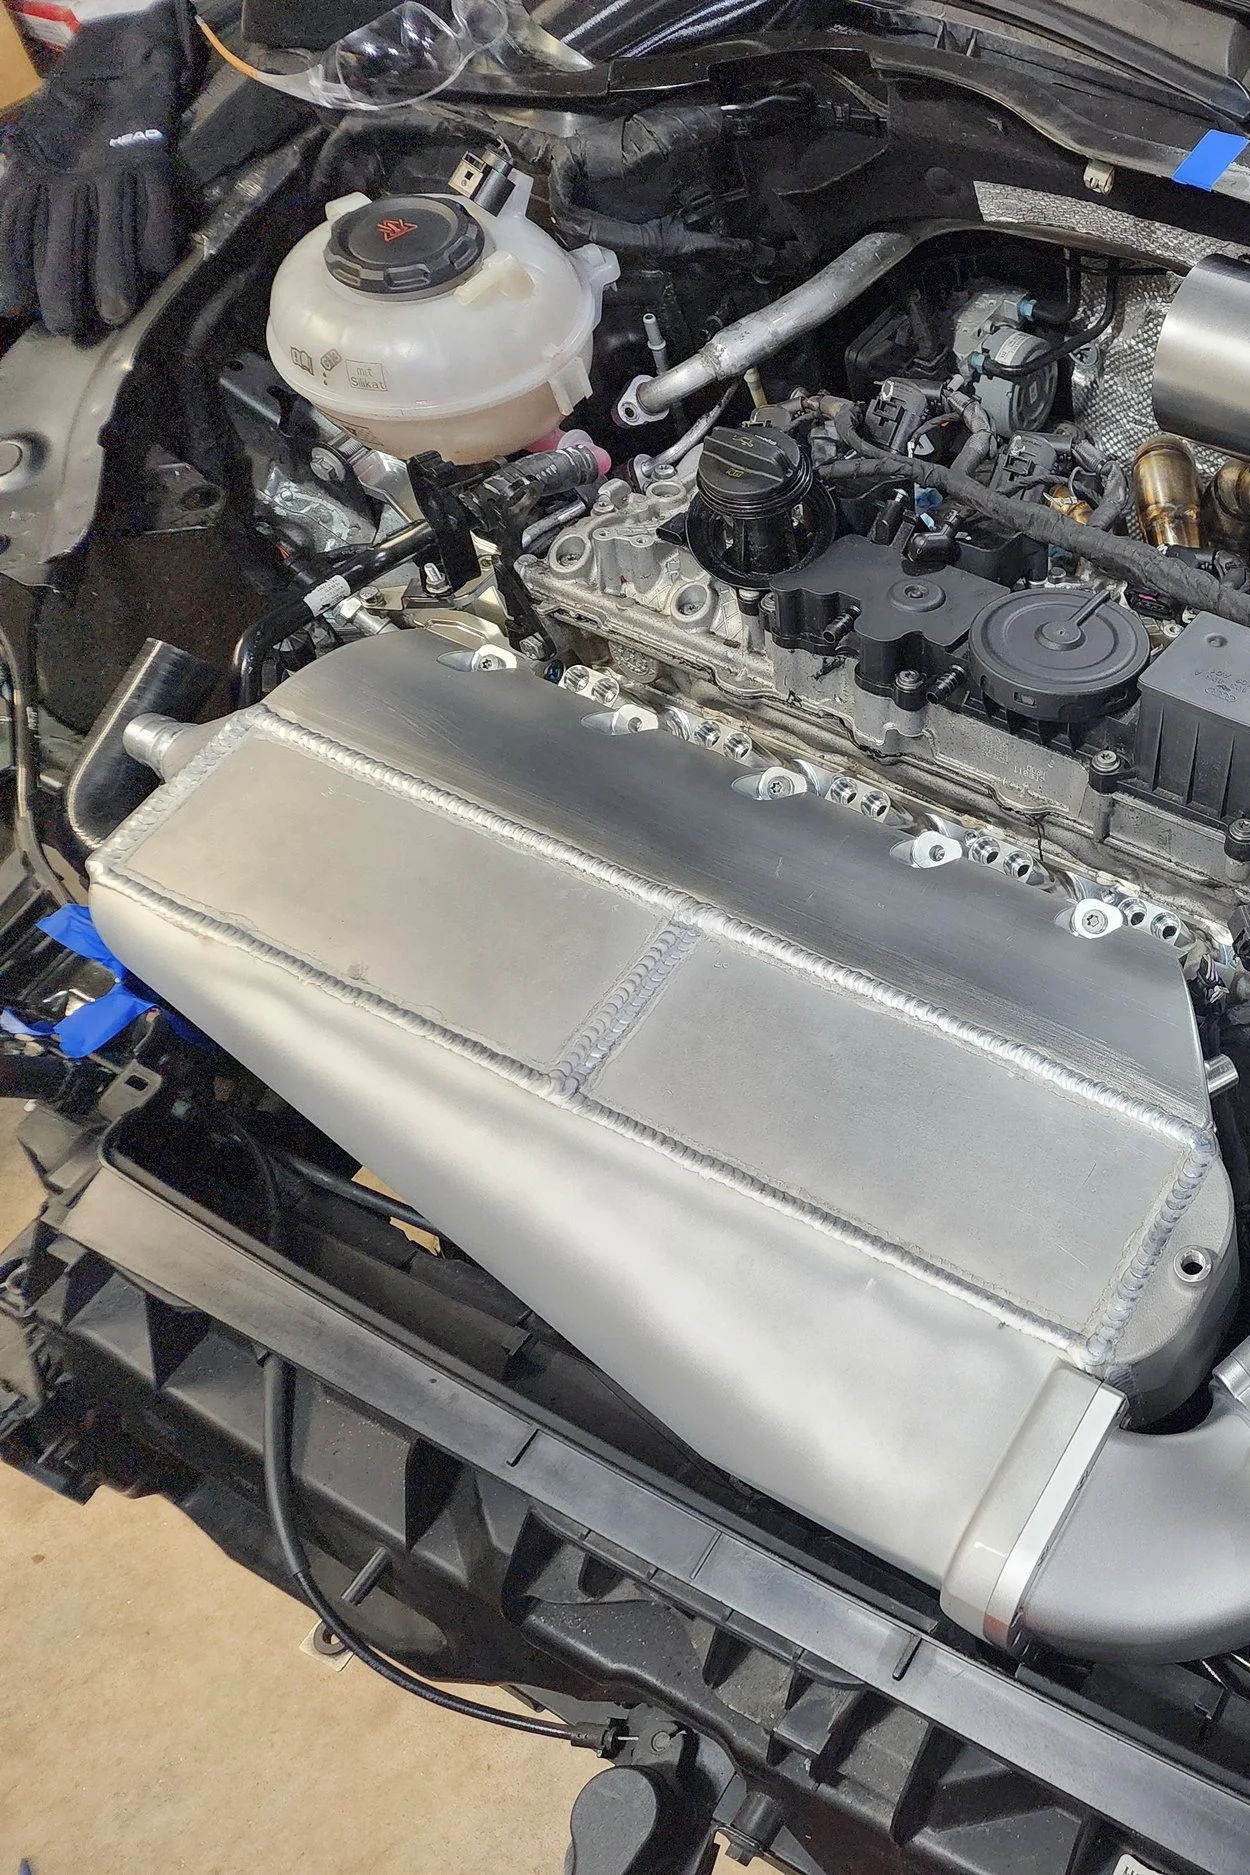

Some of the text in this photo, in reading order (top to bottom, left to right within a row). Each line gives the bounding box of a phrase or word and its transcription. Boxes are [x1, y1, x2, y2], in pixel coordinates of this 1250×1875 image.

[109, 129, 164, 147] HEAD
[356, 367, 373, 377] mit
[350, 376, 385, 390] Silikat
